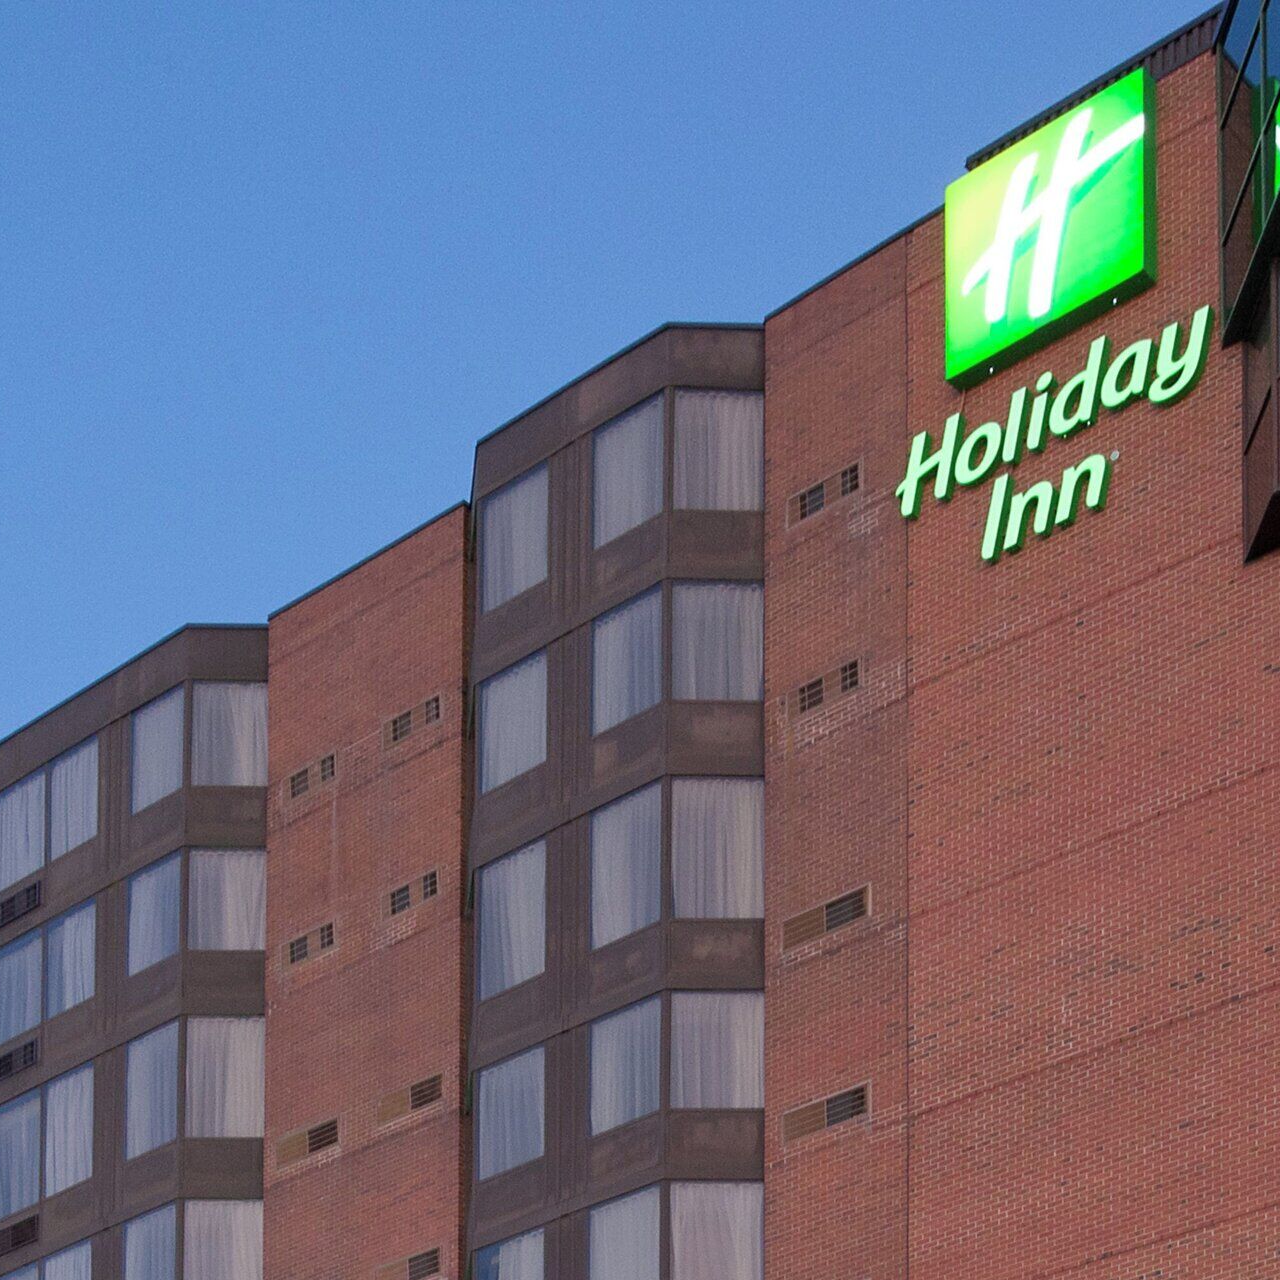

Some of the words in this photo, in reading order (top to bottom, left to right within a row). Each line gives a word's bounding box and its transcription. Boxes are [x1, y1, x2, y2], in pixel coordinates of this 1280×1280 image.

[961, 107, 1145, 323] H
[895, 304, 1211, 518] Holiday
[981, 453, 1108, 562] Inn
